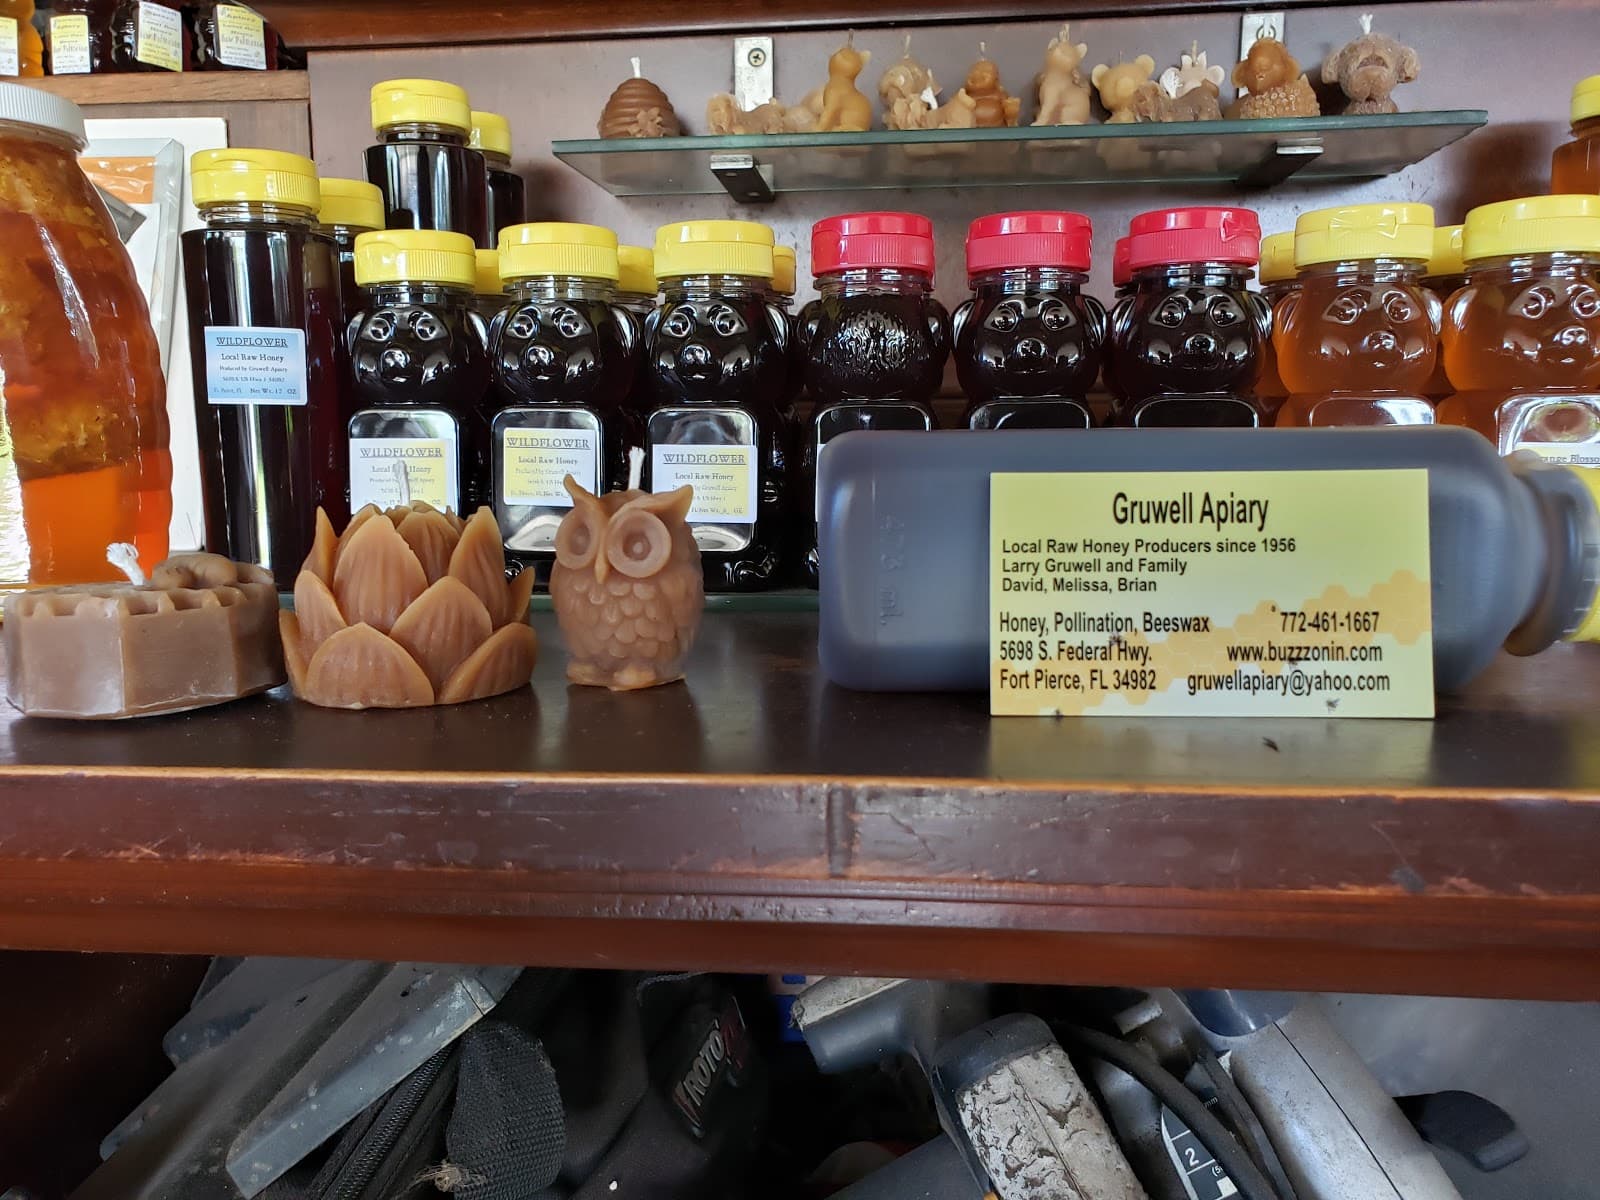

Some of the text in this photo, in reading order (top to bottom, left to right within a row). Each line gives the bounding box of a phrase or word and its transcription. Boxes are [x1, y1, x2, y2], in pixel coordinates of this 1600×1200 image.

[216, 337, 288, 348] WILDFLOWER
[221, 353, 284, 363] Local Raw Honey
[506, 437, 591, 449] WILDFLOWER
[360, 447, 442, 458] WILDFLOWER
[518, 456, 536, 464] Local
[556, 457, 578, 466] Honey
[663, 454, 746, 465] WILDFLOWER
[1570, 454, 1600, 463] Blosso
[409, 466, 432, 474] Honey
[675, 472, 693, 480] Local
[712, 472, 734, 481] Honey
[1112, 491, 1270, 533] Gruwell Apiary
[1002, 538, 1296, 556] Local Raw Honey Producers since 1956
[1002, 558, 1188, 576] Larry Gruwell and Family
[1002, 577, 1157, 594] David, Melissa, Brian
[999, 610, 1210, 639] Honey, Pollination, Beeswax
[1280, 611, 1380, 633] 772-461-1667
[999, 640, 1152, 666] 5698 S. Federal Hwy.
[1227, 640, 1382, 662] www.buzzzonin.com
[1000, 668, 1156, 694] Fort Pierce, FL 34982
[1187, 669, 1390, 696] gruwellapiary@yahoo.com
[1184, 1147, 1200, 1167] 2
